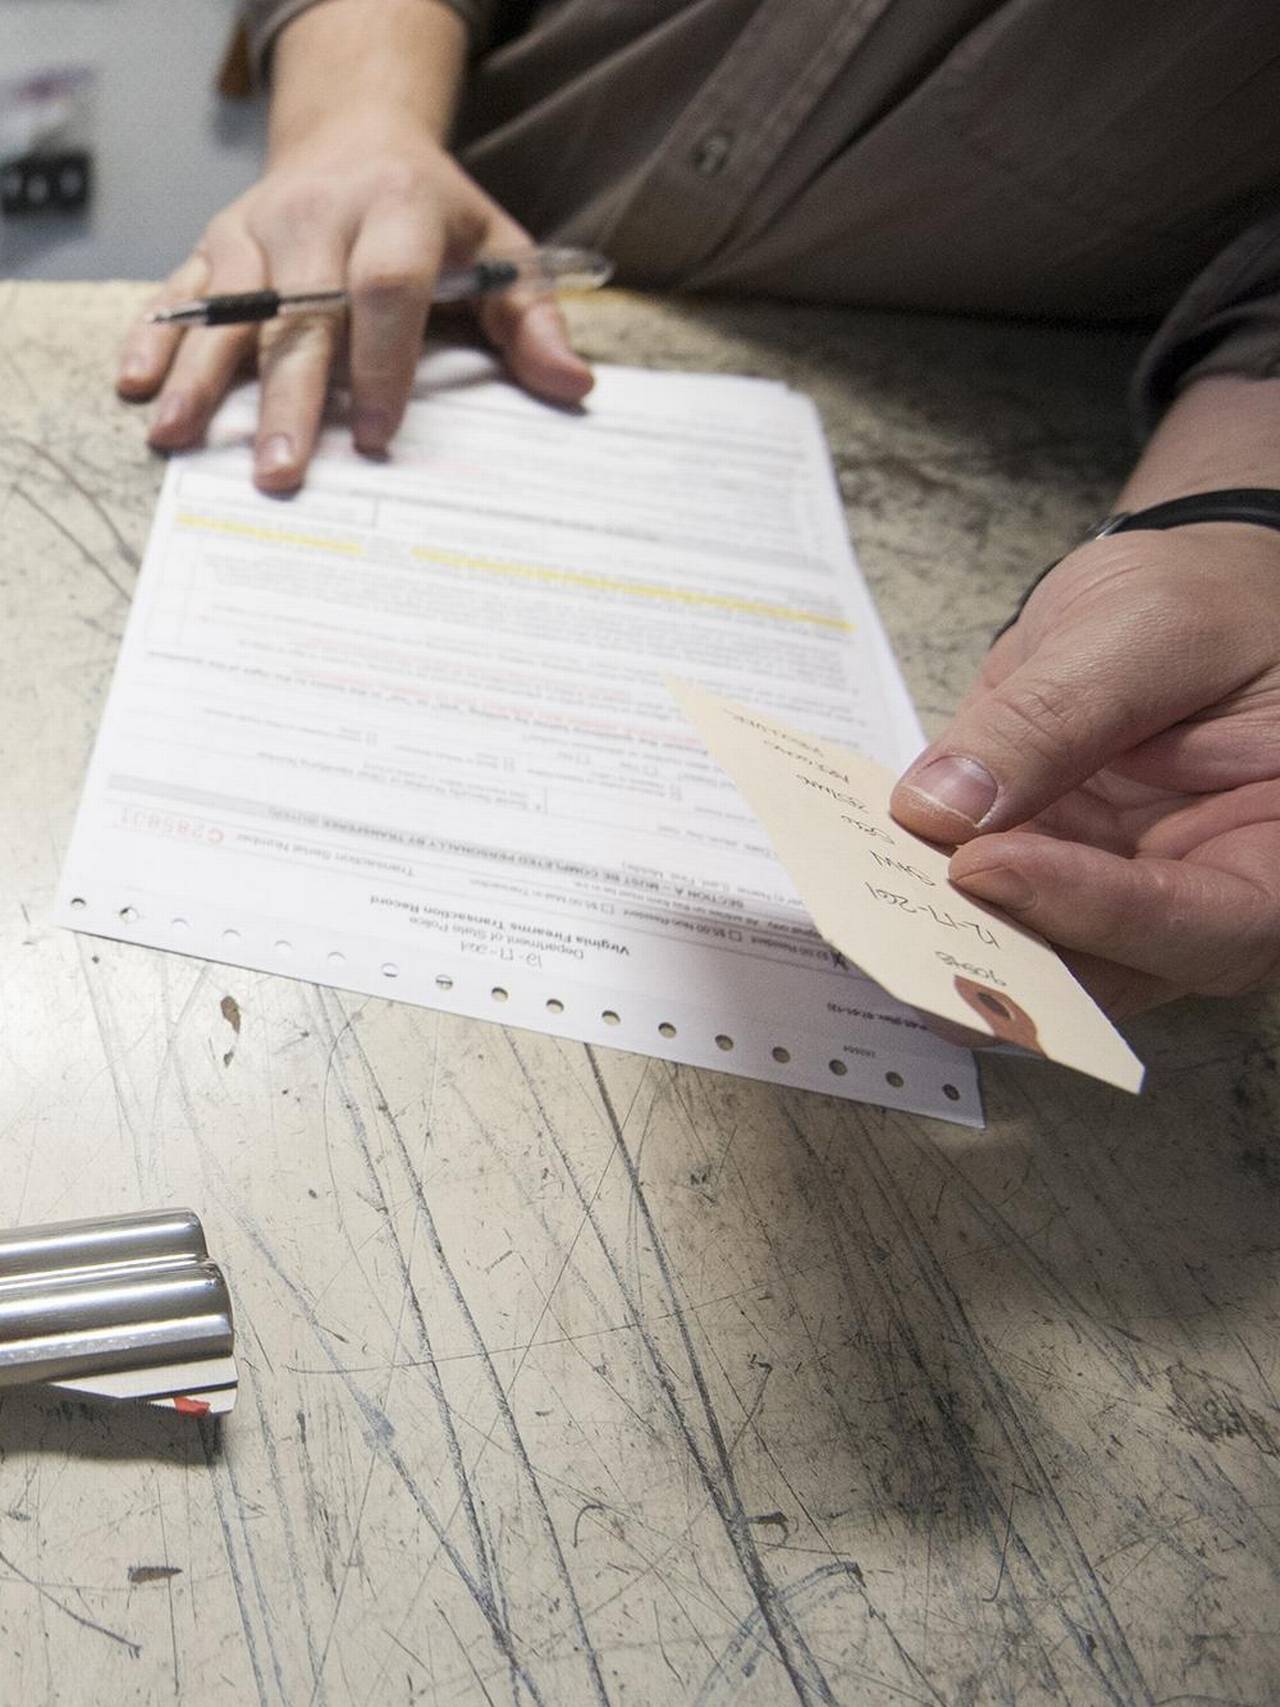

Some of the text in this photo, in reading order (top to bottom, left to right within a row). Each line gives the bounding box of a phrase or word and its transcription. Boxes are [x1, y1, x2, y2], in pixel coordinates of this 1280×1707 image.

[236, 833, 413, 877] Transaction Serial Number
[369, 895, 629, 955] Virginia Firearms Transaction Record
[408, 916, 448, 932] Police
[451, 924, 486, 939] State
[506, 935, 584, 960] Department
